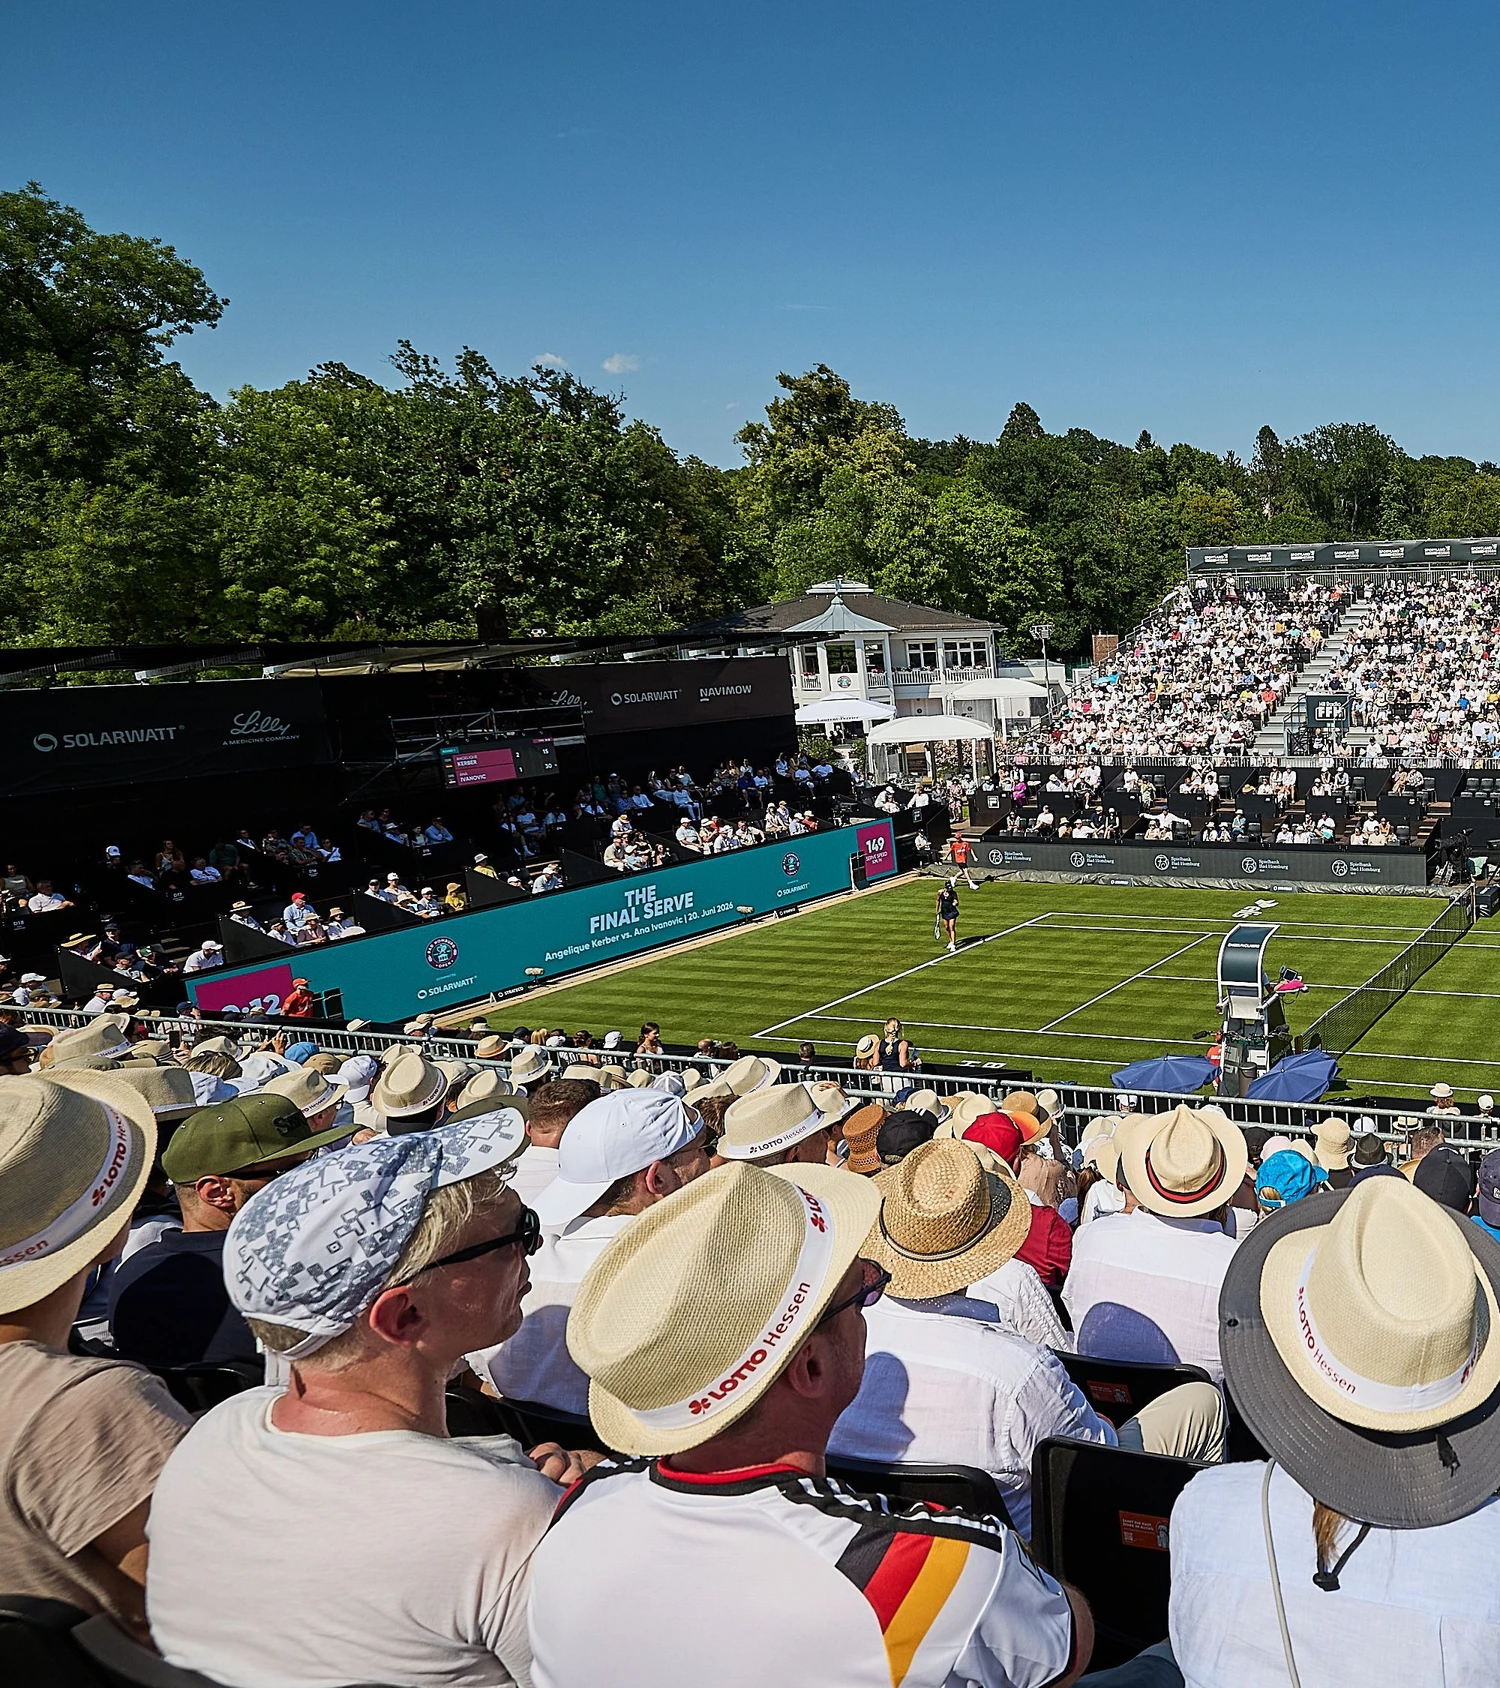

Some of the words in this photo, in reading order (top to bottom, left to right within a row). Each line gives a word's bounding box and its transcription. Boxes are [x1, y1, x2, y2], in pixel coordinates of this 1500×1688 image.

[624, 690, 680, 704] SOLARWATT
[700, 685, 752, 702] NAVIMOW
[231, 711, 290, 735] Lilly
[64, 727, 177, 749] SOLARWATT
[229, 736, 264, 745] MEDICINE
[265, 735, 300, 743] COMPANY
[865, 837, 885, 853] 149
[624, 884, 657, 907] THE
[589, 906, 640, 934] FINAL
[643, 891, 694, 919] SERVE
[544, 942, 590, 961] Angelique
[591, 933, 620, 949] Kerber
[621, 930, 632, 939] vs.
[634, 925, 650, 937] Ana
[651, 915, 684, 932] Ivanovic
[688, 911, 699, 921] 20.
[701, 906, 716, 918] Juni
[717, 901, 734, 913] 2026
[428, 977, 474, 996] SOLARWATT
[758, 1139, 783, 1151] LOTTO
[783, 1125, 807, 1141] Hessen
[104, 1142, 126, 1188] LOTTO
[708, 1349, 768, 1401] LOTTO
[763, 1282, 811, 1347] Hessen
[1299, 1301, 1315, 1349] LOTTO
[1313, 1348, 1356, 1394] Hessen
